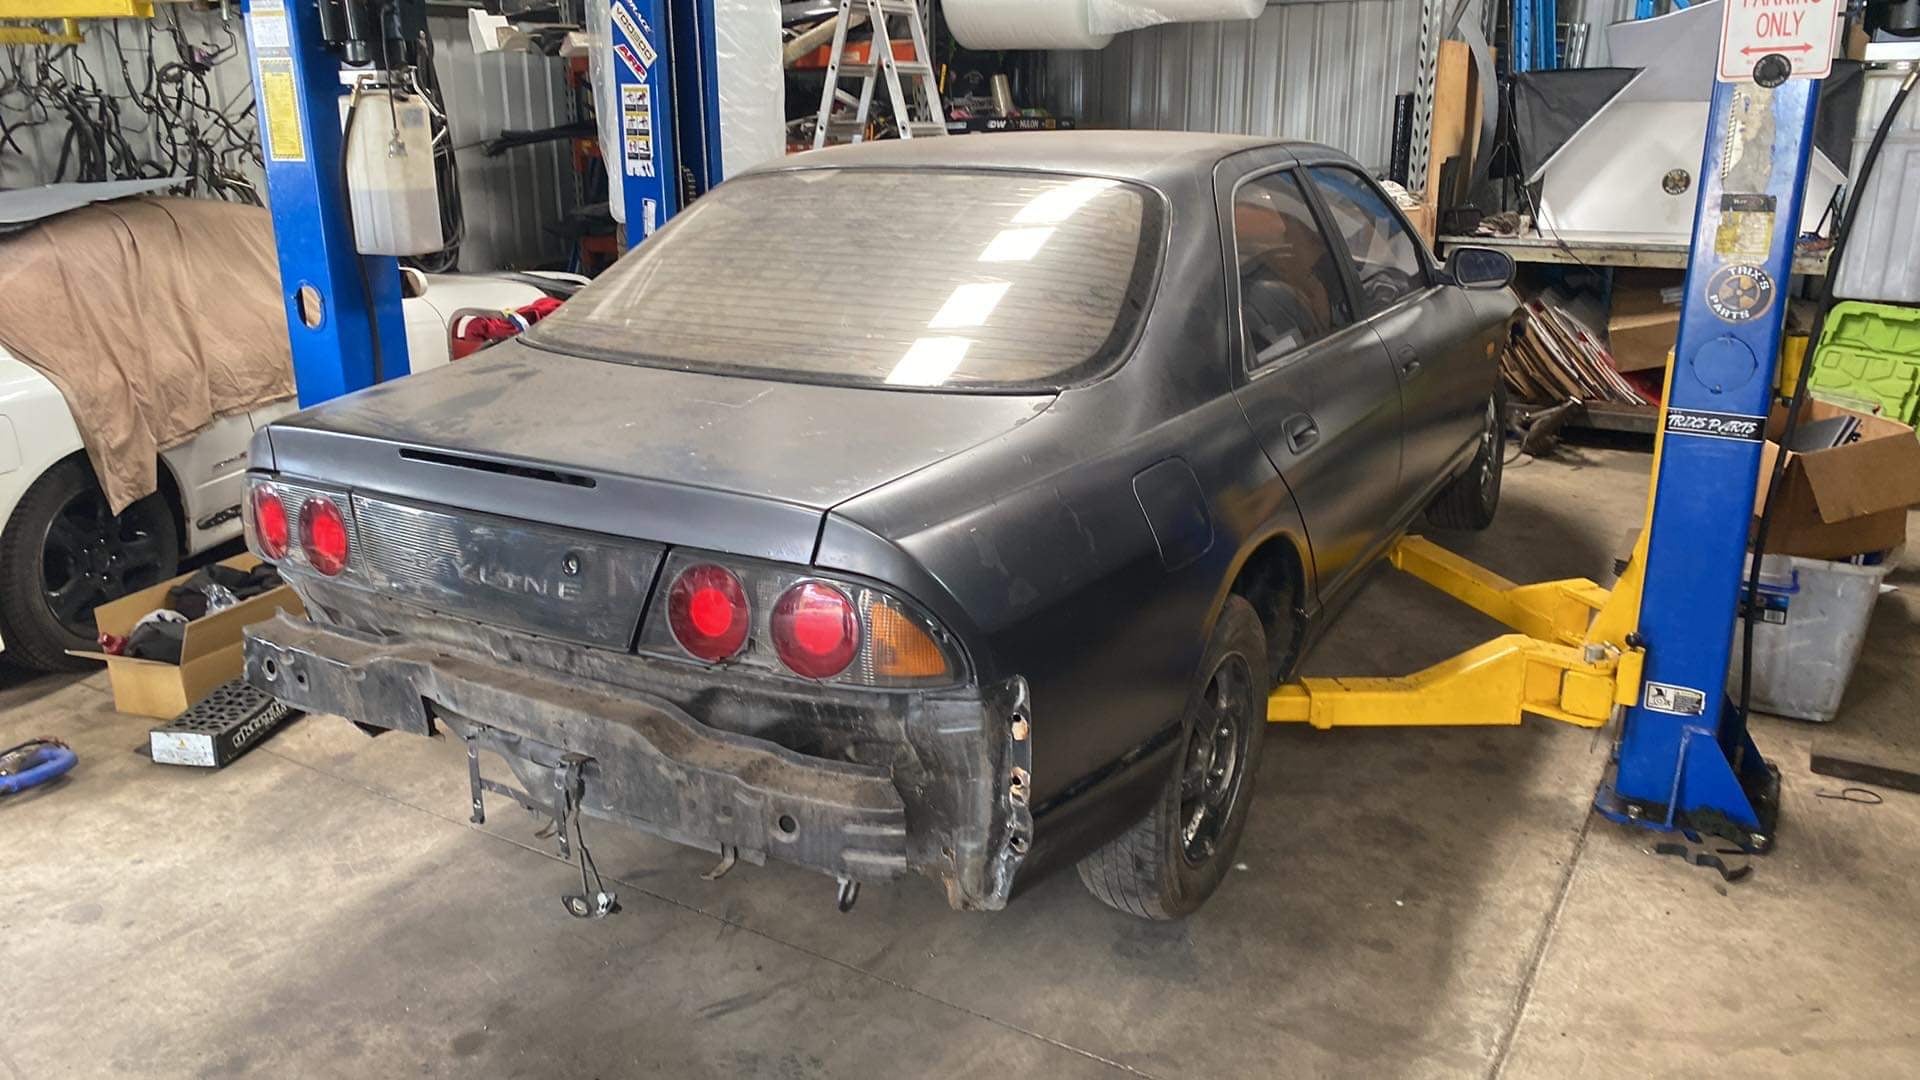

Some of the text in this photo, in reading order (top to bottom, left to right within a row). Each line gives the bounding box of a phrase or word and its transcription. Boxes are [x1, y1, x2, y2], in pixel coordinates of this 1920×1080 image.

[1756, 10, 1805, 38] ONLY
[1709, 294, 1750, 320] PARTS
[1708, 418, 1758, 434] PARTS
